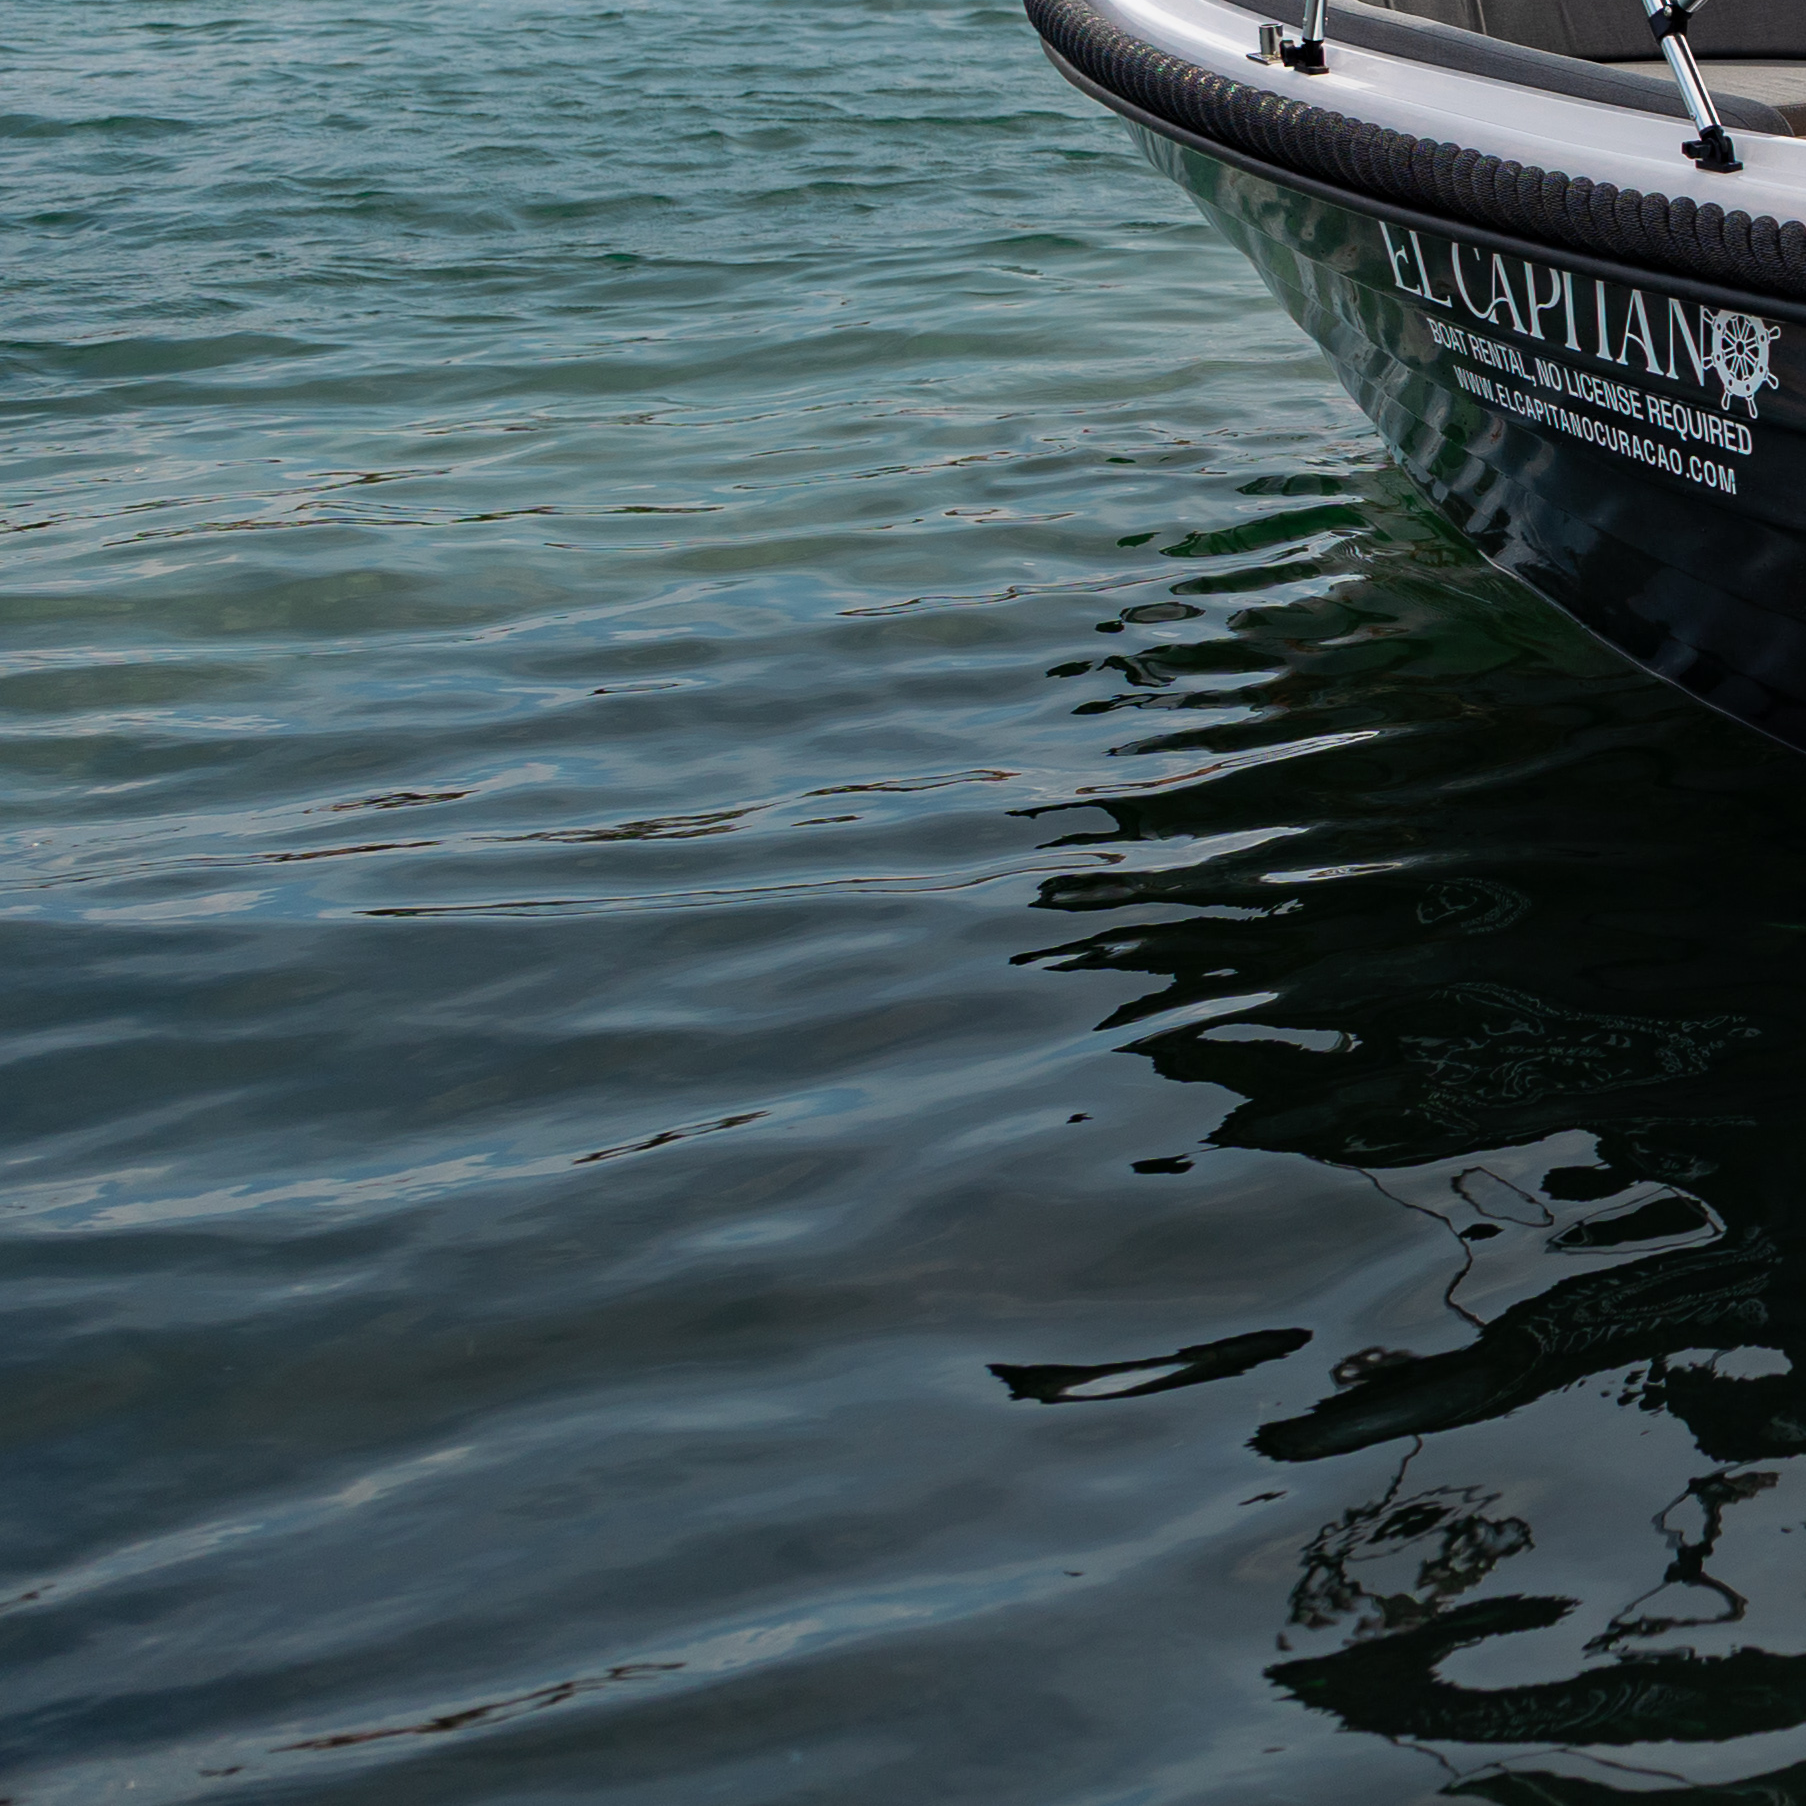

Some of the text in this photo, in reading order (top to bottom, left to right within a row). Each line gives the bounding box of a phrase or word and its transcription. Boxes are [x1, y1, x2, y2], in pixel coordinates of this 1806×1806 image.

[1378, 220, 1453, 308] EL
[1425, 317, 1753, 456] BOAT RENTAL, NO LICENSE REQUIRED
